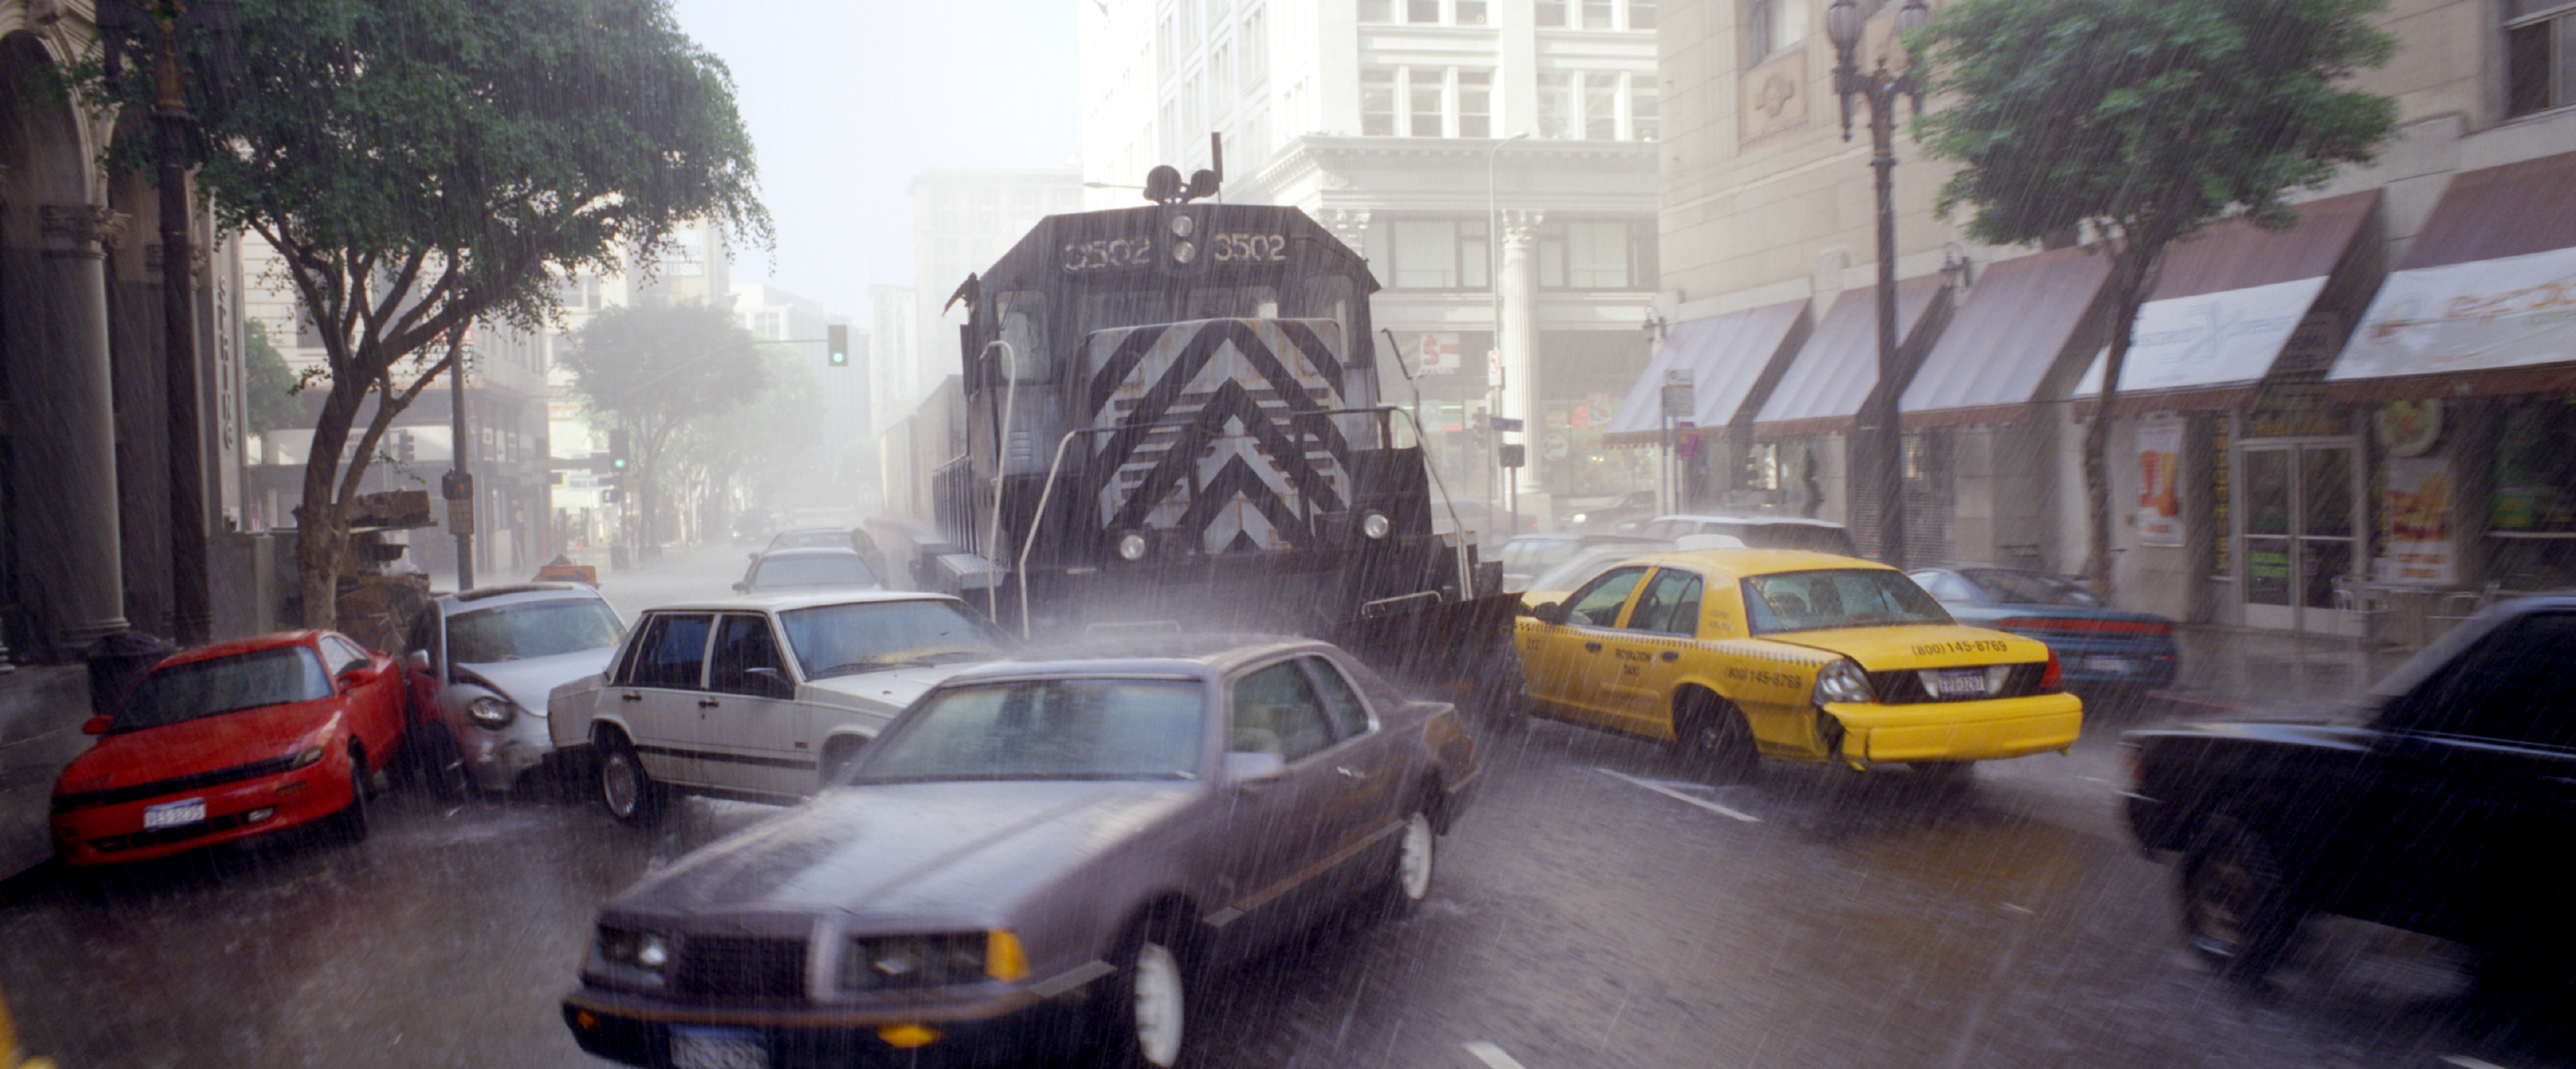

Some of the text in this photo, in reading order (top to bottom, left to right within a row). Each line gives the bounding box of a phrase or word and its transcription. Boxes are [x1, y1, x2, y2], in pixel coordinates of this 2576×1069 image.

[1065, 238, 1151, 270] 3502
[1215, 232, 1286, 261] 3502
[217, 275, 234, 450] SPRING
[1911, 640, 2008, 658] (800) 145-8769
[1624, 665, 1640, 677] TAXI
[1725, 665, 1801, 689] (800) 145-8769
